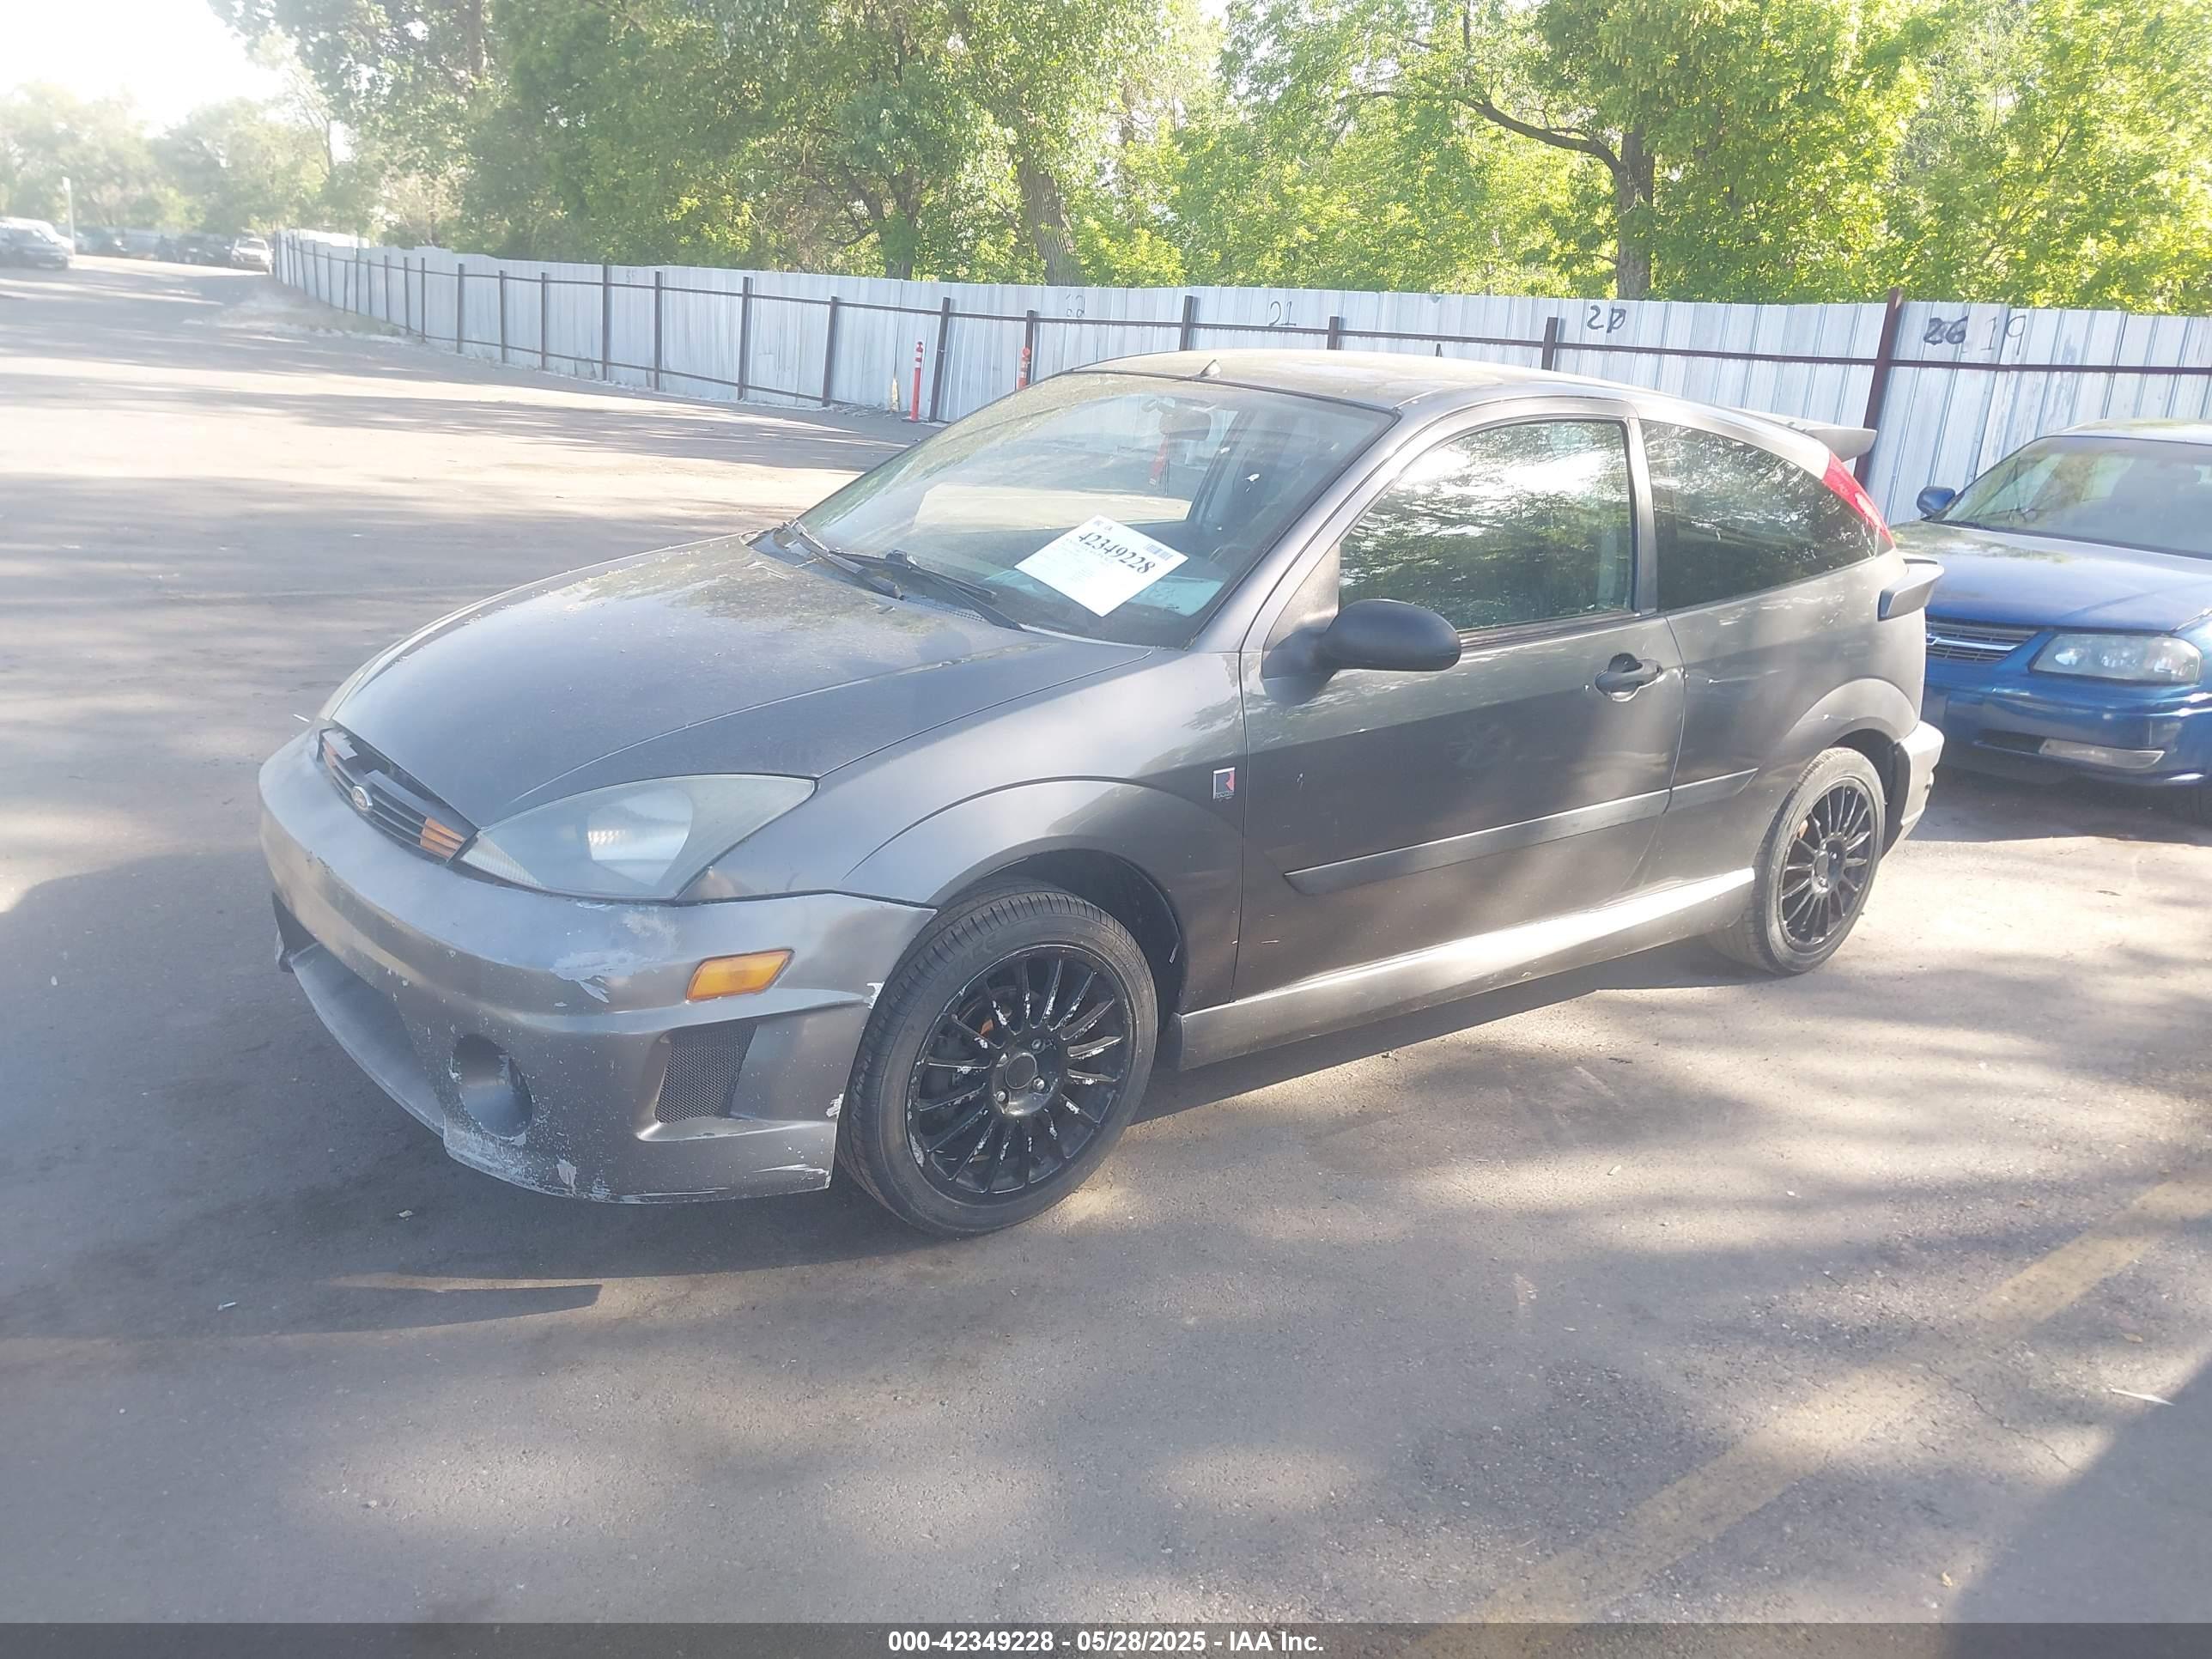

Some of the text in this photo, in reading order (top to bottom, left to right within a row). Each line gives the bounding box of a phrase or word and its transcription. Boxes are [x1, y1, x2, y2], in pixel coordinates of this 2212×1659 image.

[1268, 301, 1297, 327] 21
[1979, 314, 2027, 356] 19
[1078, 532, 1156, 574] 42349228
